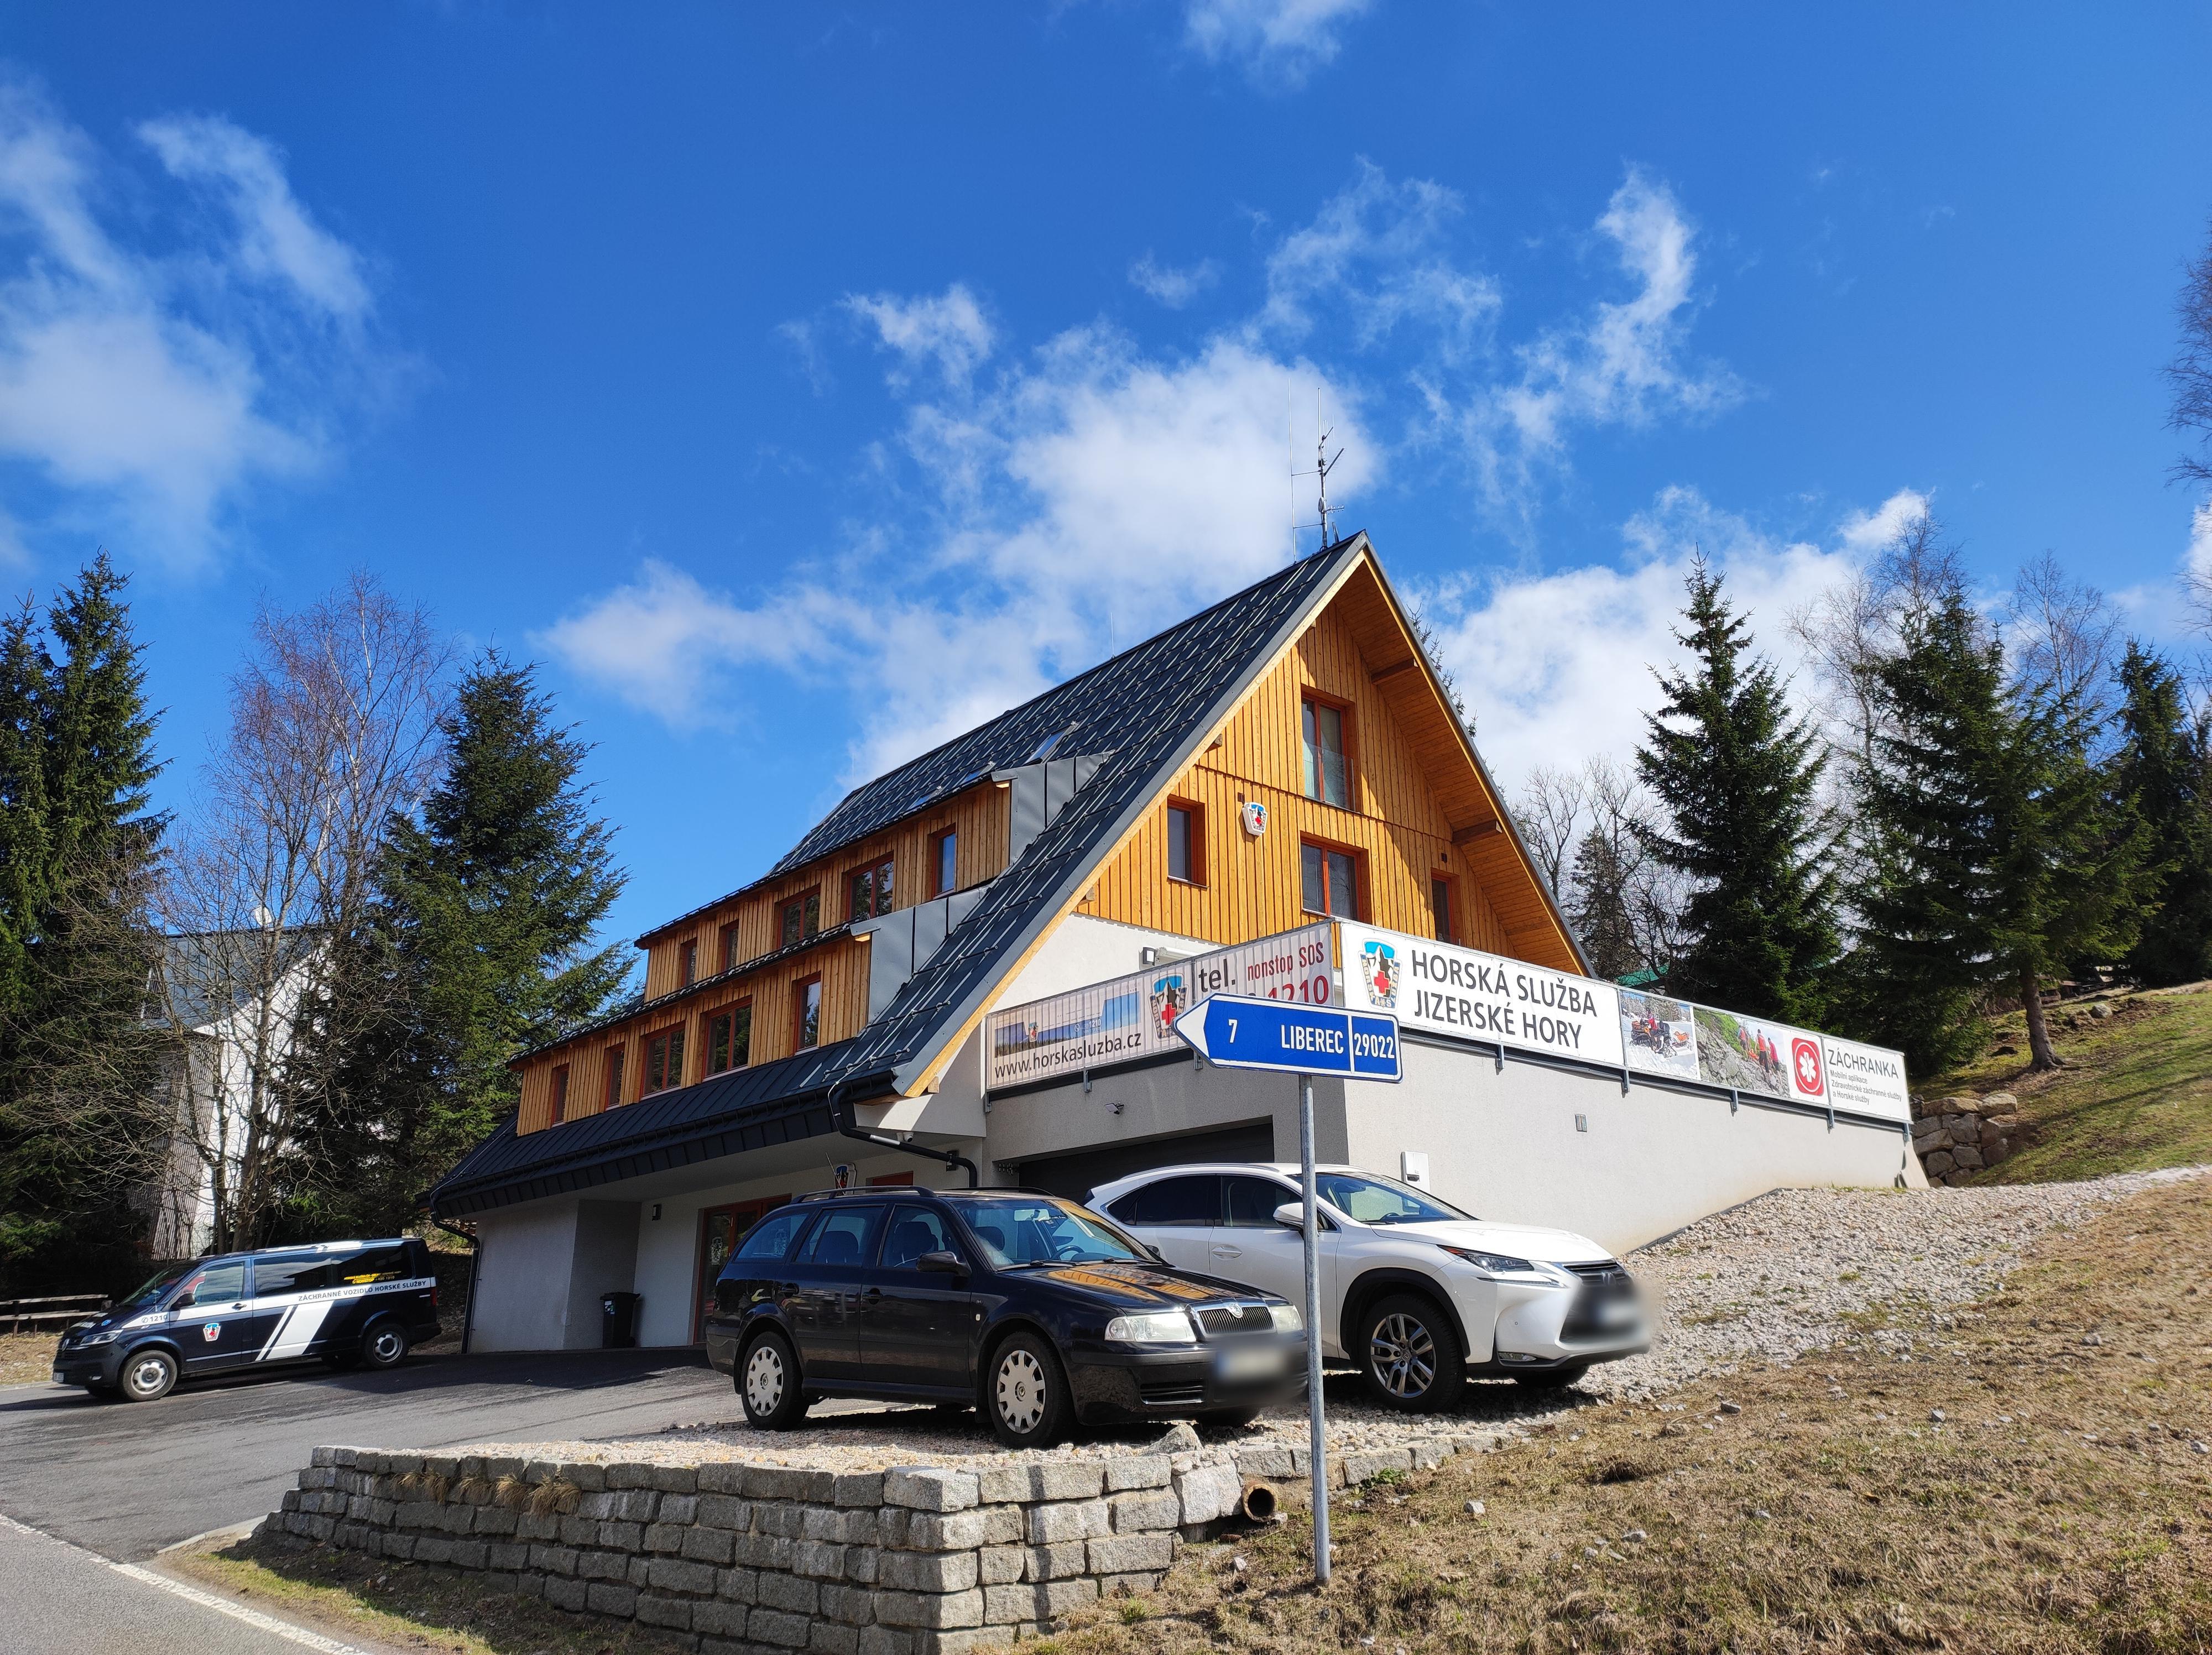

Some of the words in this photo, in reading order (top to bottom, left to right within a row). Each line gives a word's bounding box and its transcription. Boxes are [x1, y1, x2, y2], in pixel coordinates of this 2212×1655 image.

[1198, 958, 1236, 993] tel.
[1248, 954, 1293, 981] nonstop
[1299, 942, 1324, 968] SOS
[1411, 949, 1510, 998] HORSKÁ
[1517, 975, 1598, 1017] SLUŽBA
[1089, 1019, 1102, 1028] 1210
[1414, 990, 1516, 1036] JIZERSKÉ
[1522, 1012, 1582, 1049] HORY
[994, 1032, 1142, 1078] www.horskasluzba.cz
[1228, 1019, 1238, 1043] 7
[1281, 1024, 1344, 1054] LIBEREC
[1353, 1033, 1395, 1059] 29022
[1828, 1047, 1899, 1079] ZÁCHRANKA
[1848, 1074, 1868, 1084] aplikace
[1832, 1079, 1863, 1092] Zdravotnické
[1863, 1087, 1887, 1098] záchranné
[1887, 1091, 1902, 1102] služby
[1837, 1090, 1854, 1100] Horské
[1855, 1095, 1870, 1105] služby
[299, 1291, 342, 1301] ZÁCHRANNÉ
[343, 1287, 373, 1296] VOZIDLO
[375, 1283, 401, 1292] HORSKÉ
